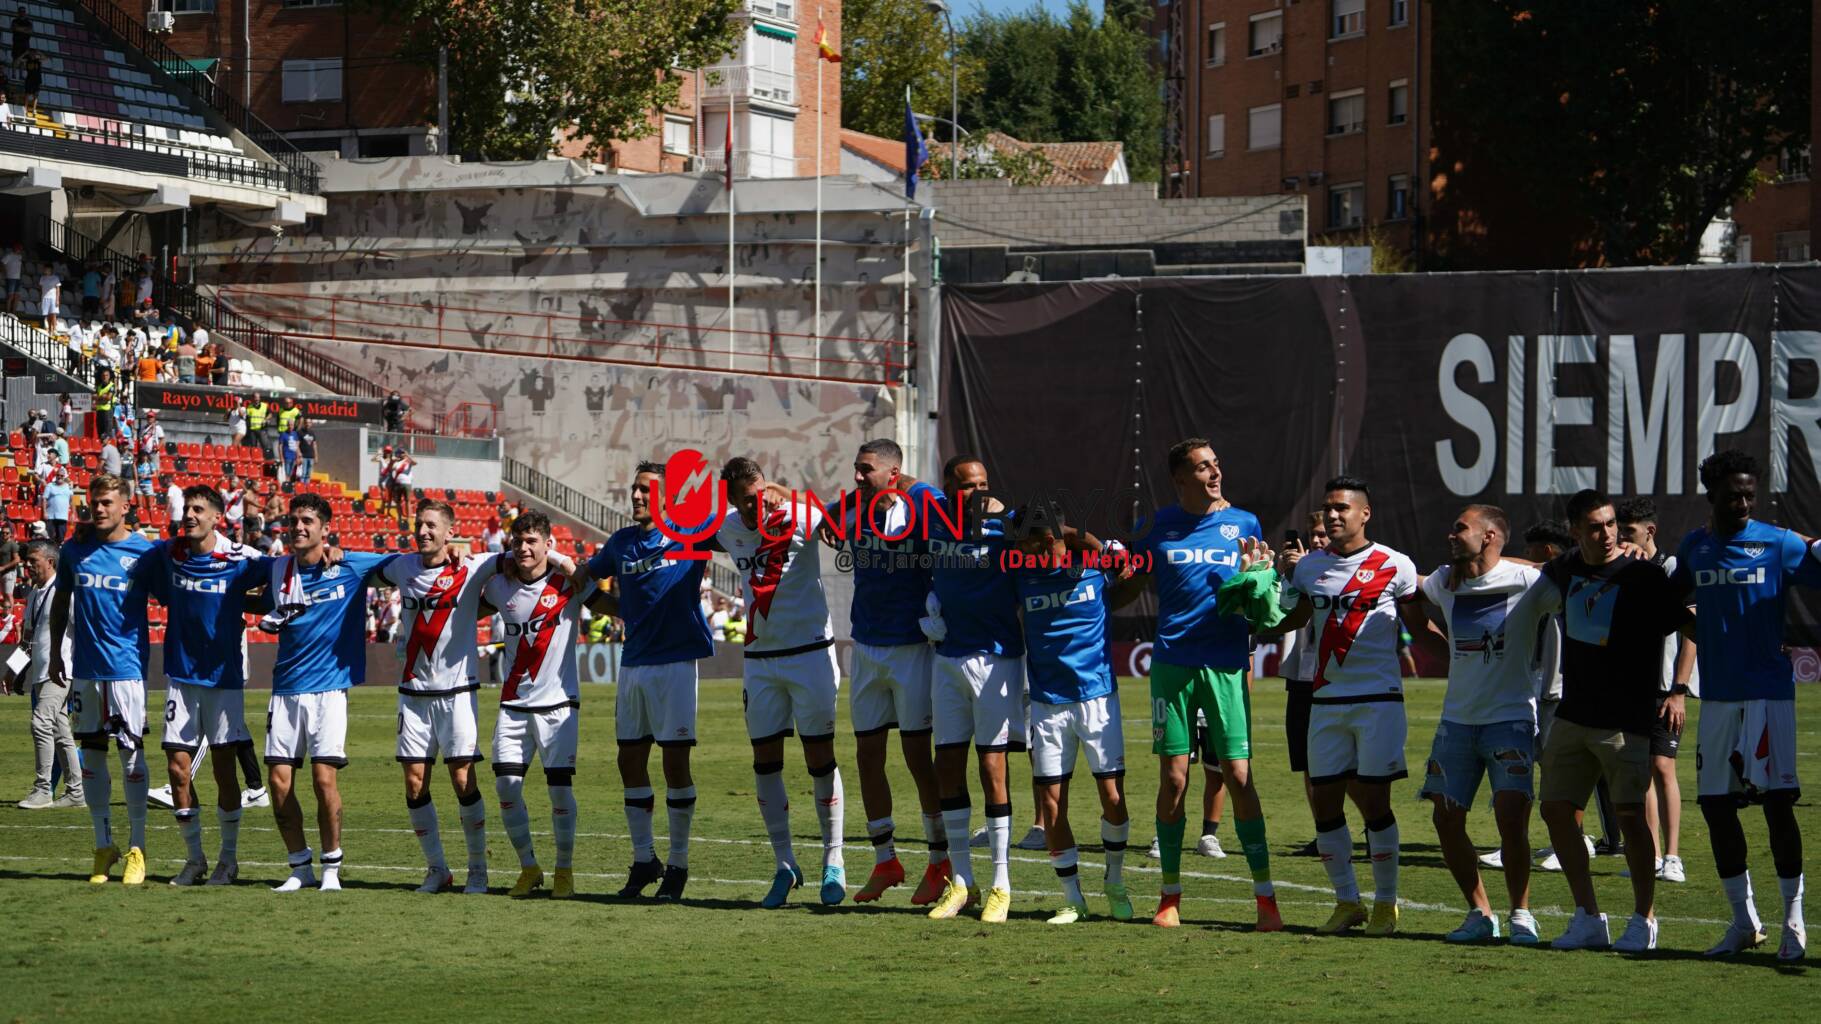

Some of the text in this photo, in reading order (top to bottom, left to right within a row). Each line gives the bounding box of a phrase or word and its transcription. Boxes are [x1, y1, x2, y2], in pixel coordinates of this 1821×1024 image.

[162, 391, 201, 412] Rayo
[307, 402, 358, 417] Madrid
[1435, 330, 1821, 496] SIEMPR
[1168, 549, 1237, 567] DIGI
[74, 573, 134, 592] DIGI
[171, 574, 227, 594] DIGI
[1696, 567, 1765, 587] DIGI
[304, 585, 345, 606] IGI
[402, 596, 457, 611] DIGI
[1025, 584, 1096, 612] DIGI
[1311, 594, 1378, 610] DIGI
[505, 614, 560, 637] DIGI
